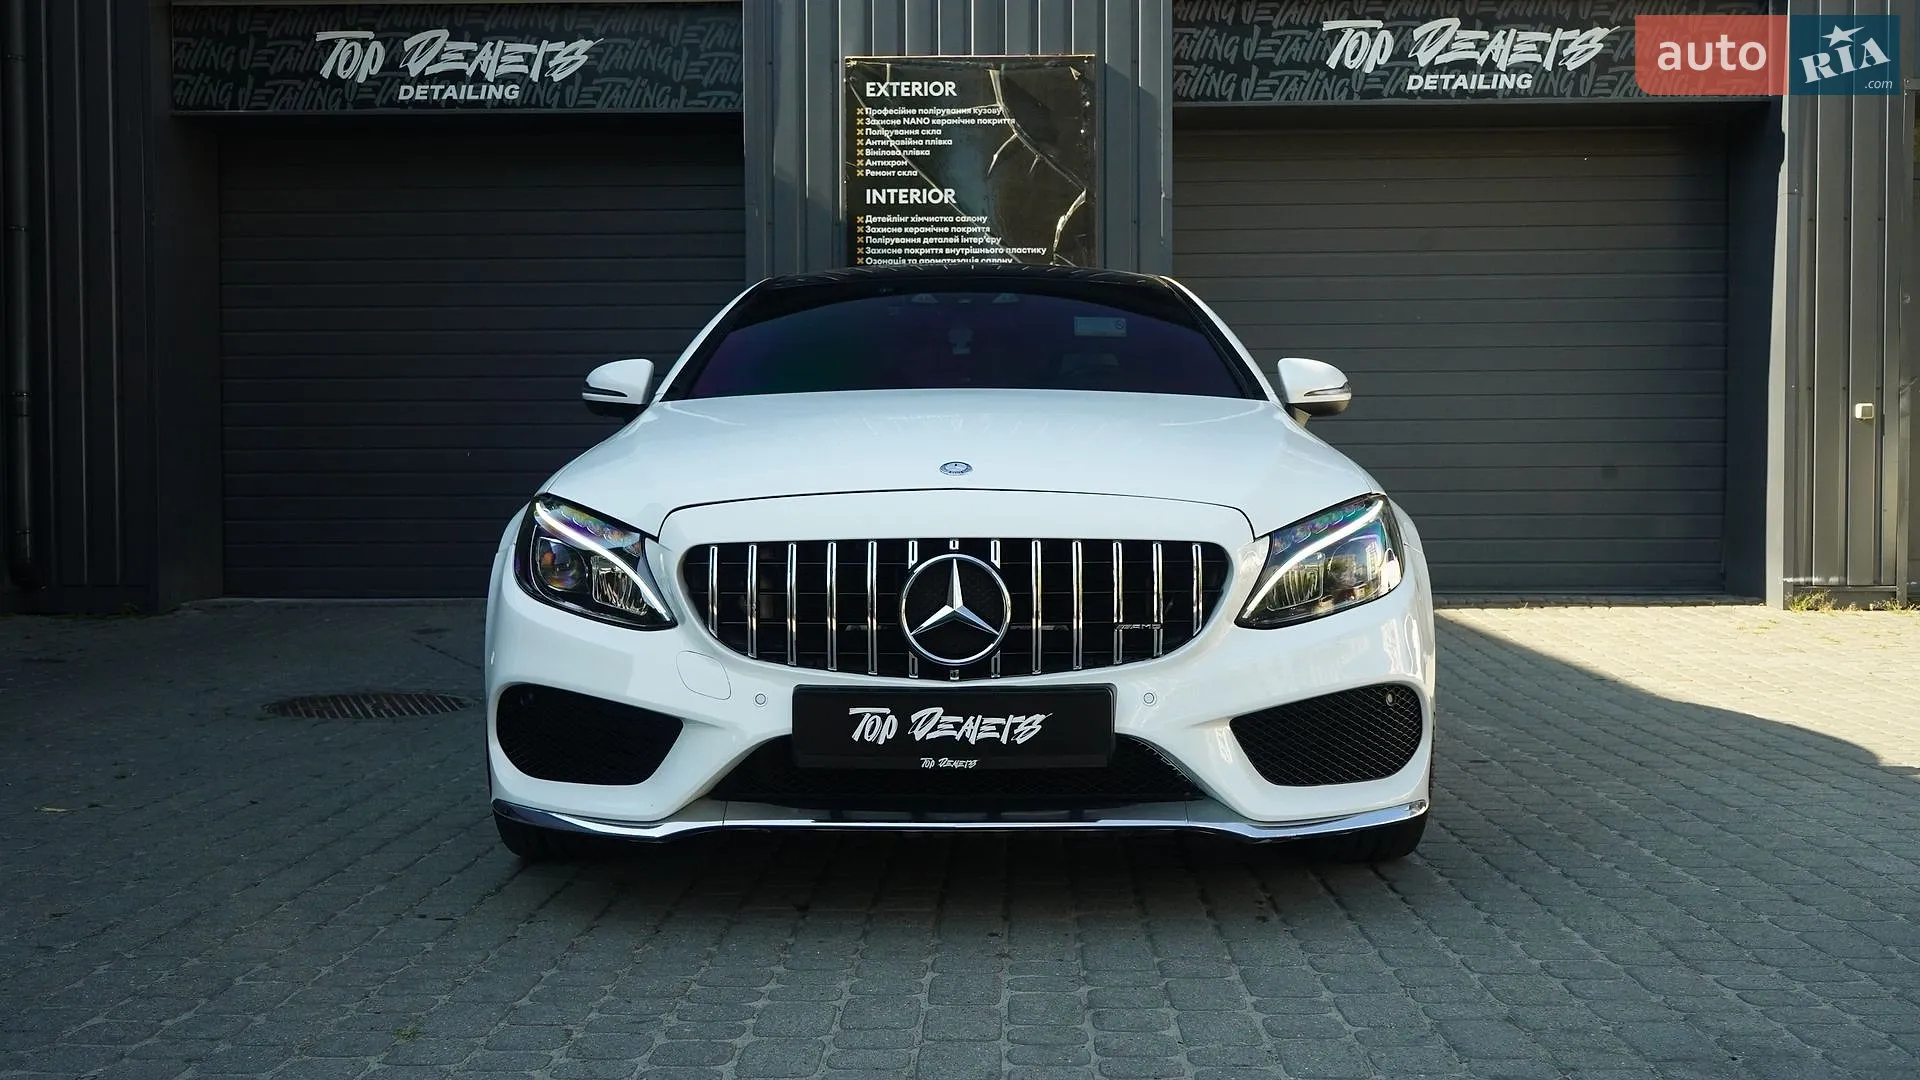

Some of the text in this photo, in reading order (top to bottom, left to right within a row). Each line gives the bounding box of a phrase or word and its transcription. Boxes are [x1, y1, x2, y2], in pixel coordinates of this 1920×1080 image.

[1407, 73, 1533, 91] DETAILING
[398, 84, 520, 101] DETAILING
[866, 82, 958, 97] EXTERIOR
[865, 107, 917, 116] Професійне
[932, 117, 975, 127] керамічне
[865, 128, 919, 137] Полірування
[865, 138, 953, 147] Антигравійна плівка
[865, 169, 918, 177] Ремонт скла
[866, 188, 957, 204] INTERIOR
[865, 214, 988, 224] Детейлінг хімчистка салону
[865, 224, 990, 234] Захисне керамічне покриття
[865, 236, 921, 245] Полірування
[923, 235, 959, 244] деталей
[865, 245, 1047, 256] Захисне покриття внутрішнього пластику
